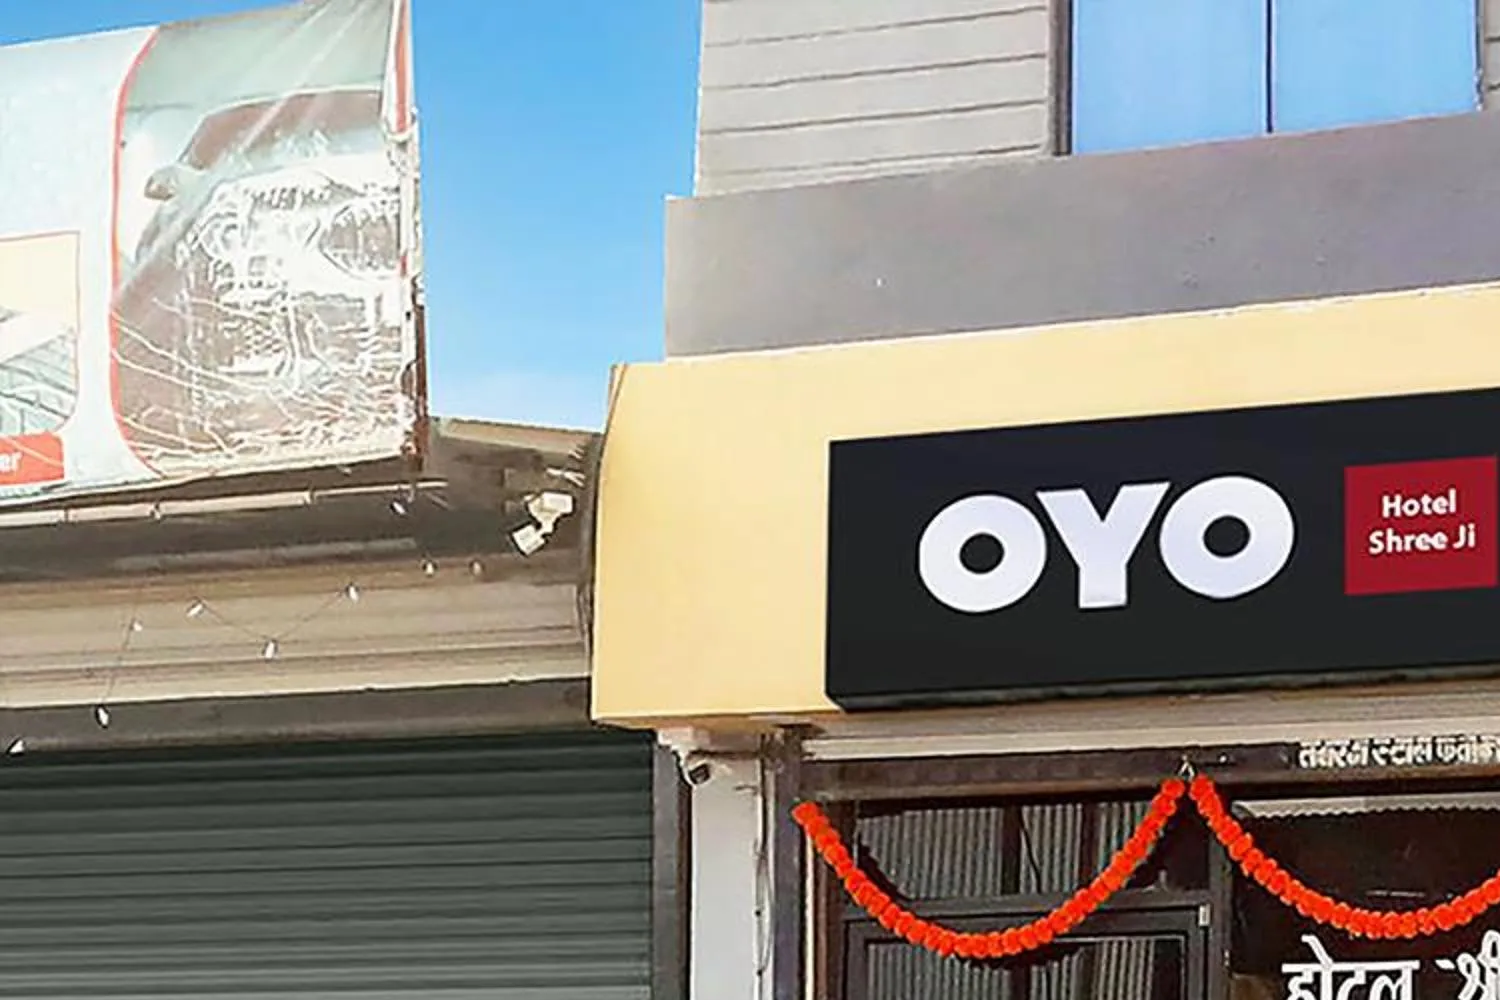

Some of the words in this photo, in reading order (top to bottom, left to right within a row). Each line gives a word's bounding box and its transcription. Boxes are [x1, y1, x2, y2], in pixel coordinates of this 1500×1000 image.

[1382, 488, 1457, 518] Hotel
[918, 475, 1295, 613] OYO
[1368, 527, 1449, 555] Shree
[1452, 523, 1476, 549] Ji
